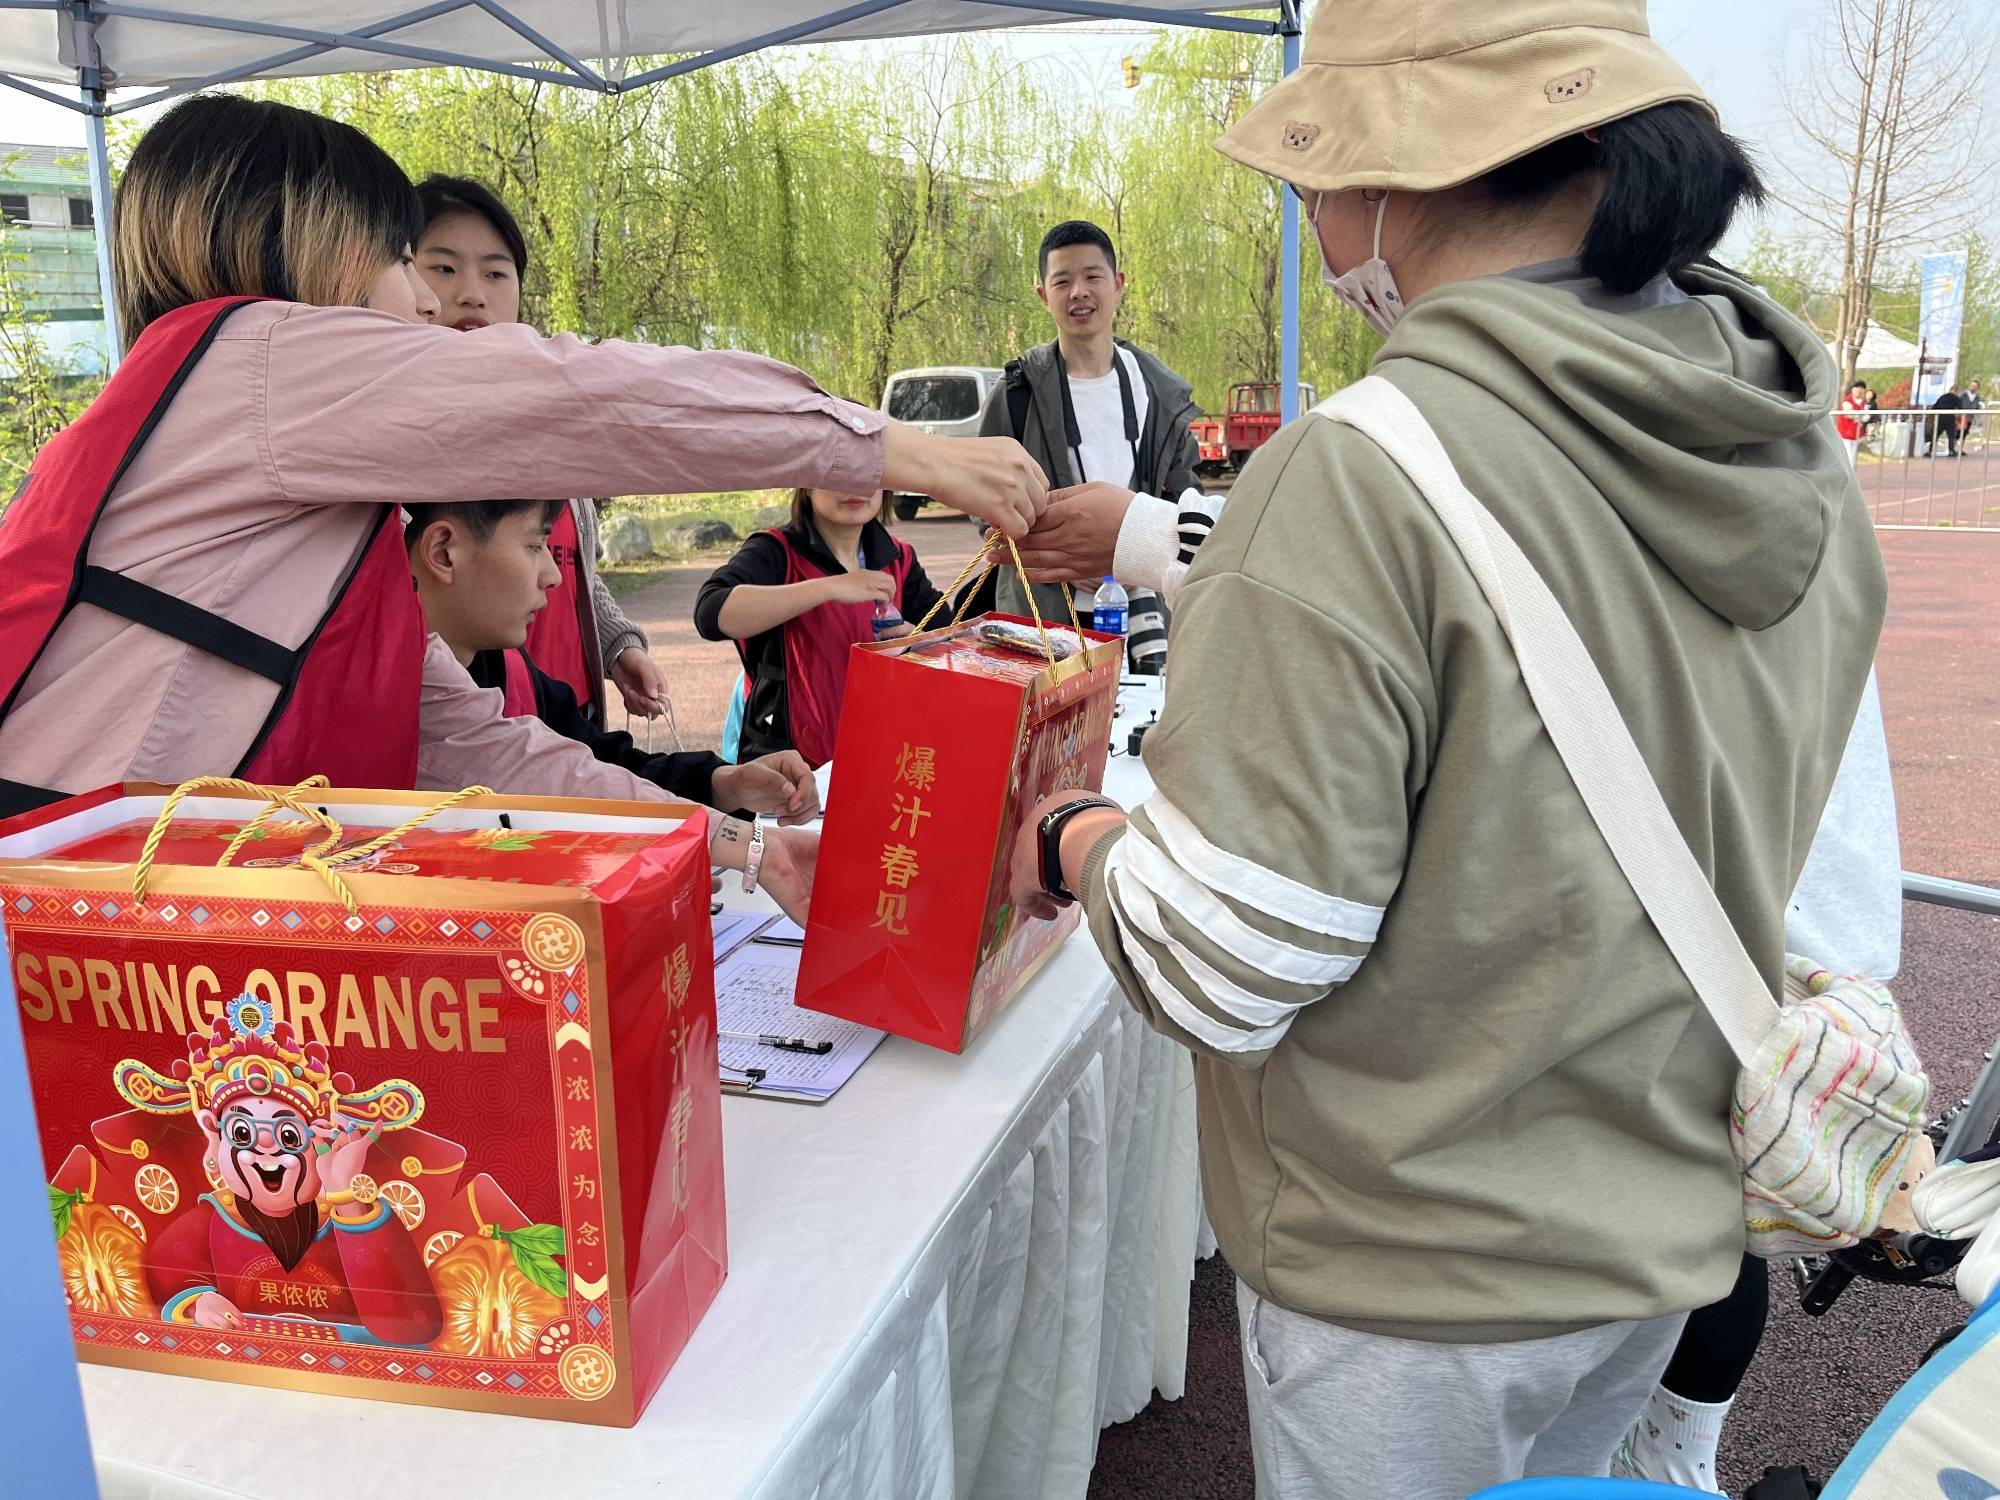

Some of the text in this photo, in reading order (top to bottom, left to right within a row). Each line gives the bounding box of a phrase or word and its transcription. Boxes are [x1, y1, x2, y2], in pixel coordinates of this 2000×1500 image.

[869, 742, 936, 935] 爆汁春见
[16, 952, 506, 1053] SPRING ORANGE
[661, 942, 693, 1227] 爆汁春见
[566, 1076, 600, 1247] 浓浓为念
